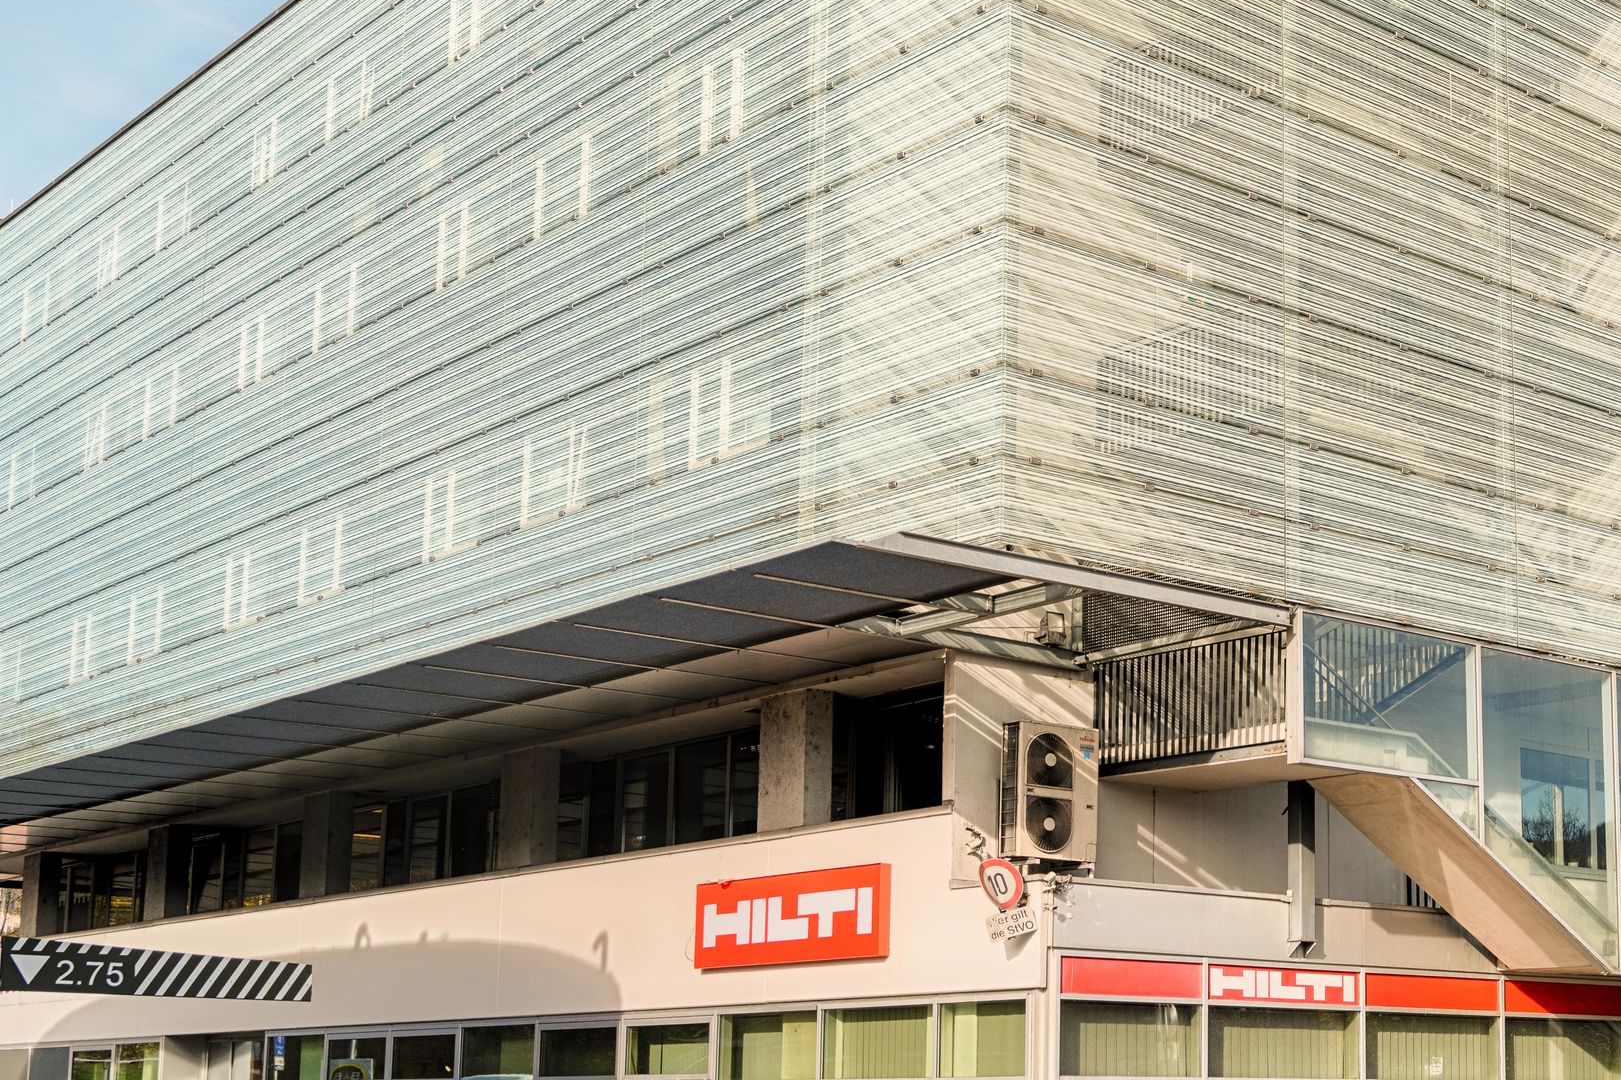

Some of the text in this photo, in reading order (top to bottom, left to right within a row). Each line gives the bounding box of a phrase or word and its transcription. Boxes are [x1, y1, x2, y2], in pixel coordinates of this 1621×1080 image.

[987, 872, 1008, 897] 10
[702, 886, 873, 948] HILTI
[1011, 909, 1028, 923] gilt
[991, 920, 1034, 941] die StVO
[55, 960, 124, 988] 2.75
[1209, 968, 1355, 1003] HILTI
